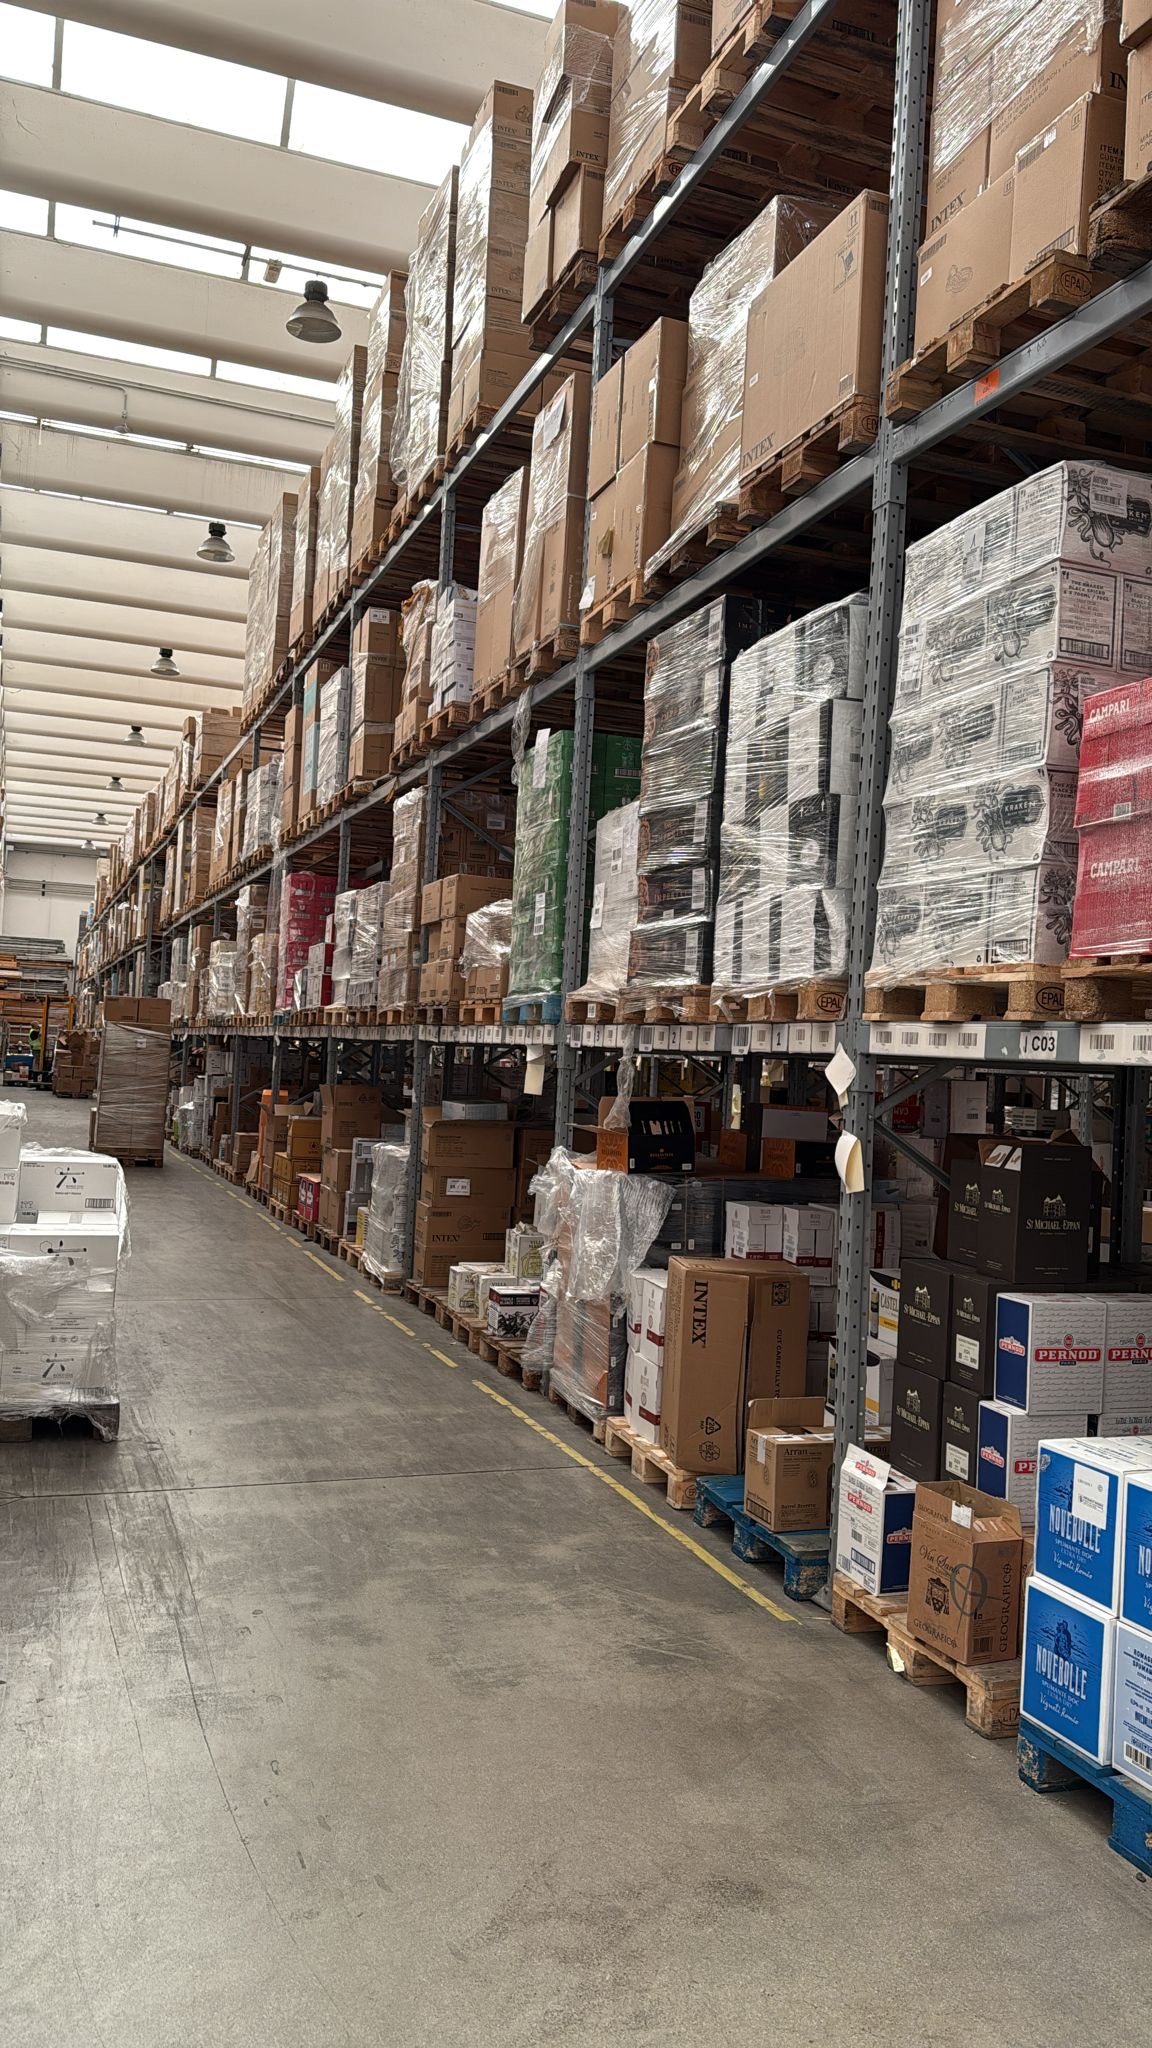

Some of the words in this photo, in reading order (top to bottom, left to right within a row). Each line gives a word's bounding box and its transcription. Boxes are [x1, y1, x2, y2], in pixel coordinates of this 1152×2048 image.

[576, 150, 600, 161] INTEX
[742, 432, 776, 468] INTEX
[1090, 698, 1131, 723] CAMPARI
[1004, 801, 1036, 813] KRAKEN
[1090, 856, 1141, 879] CAMPARI
[820, 996, 843, 1011] EPAL
[1041, 992, 1064, 1006] EPAL
[671, 1031, 677, 1043] 2
[776, 1031, 782, 1046] 1
[1032, 1036, 1055, 1052] C03
[432, 1234, 461, 1243] INTEX
[691, 1279, 709, 1345] INTEX
[1001, 1343, 1025, 1354] PERNOD
[1038, 1350, 1098, 1360] PERNOD
[784, 1448, 808, 1456] Arran
[856, 1462, 876, 1477] PERNOD
[848, 1493, 872, 1513] PERNOD
[1055, 1538, 1081, 1554] SPUMANTE
[1081, 1550, 1093, 1560] DOC
[1036, 1644, 1088, 1700] NOVEBOLLE
[1042, 1680, 1067, 1699] SPUMANTE
[1067, 1694, 1080, 1705] DOC
